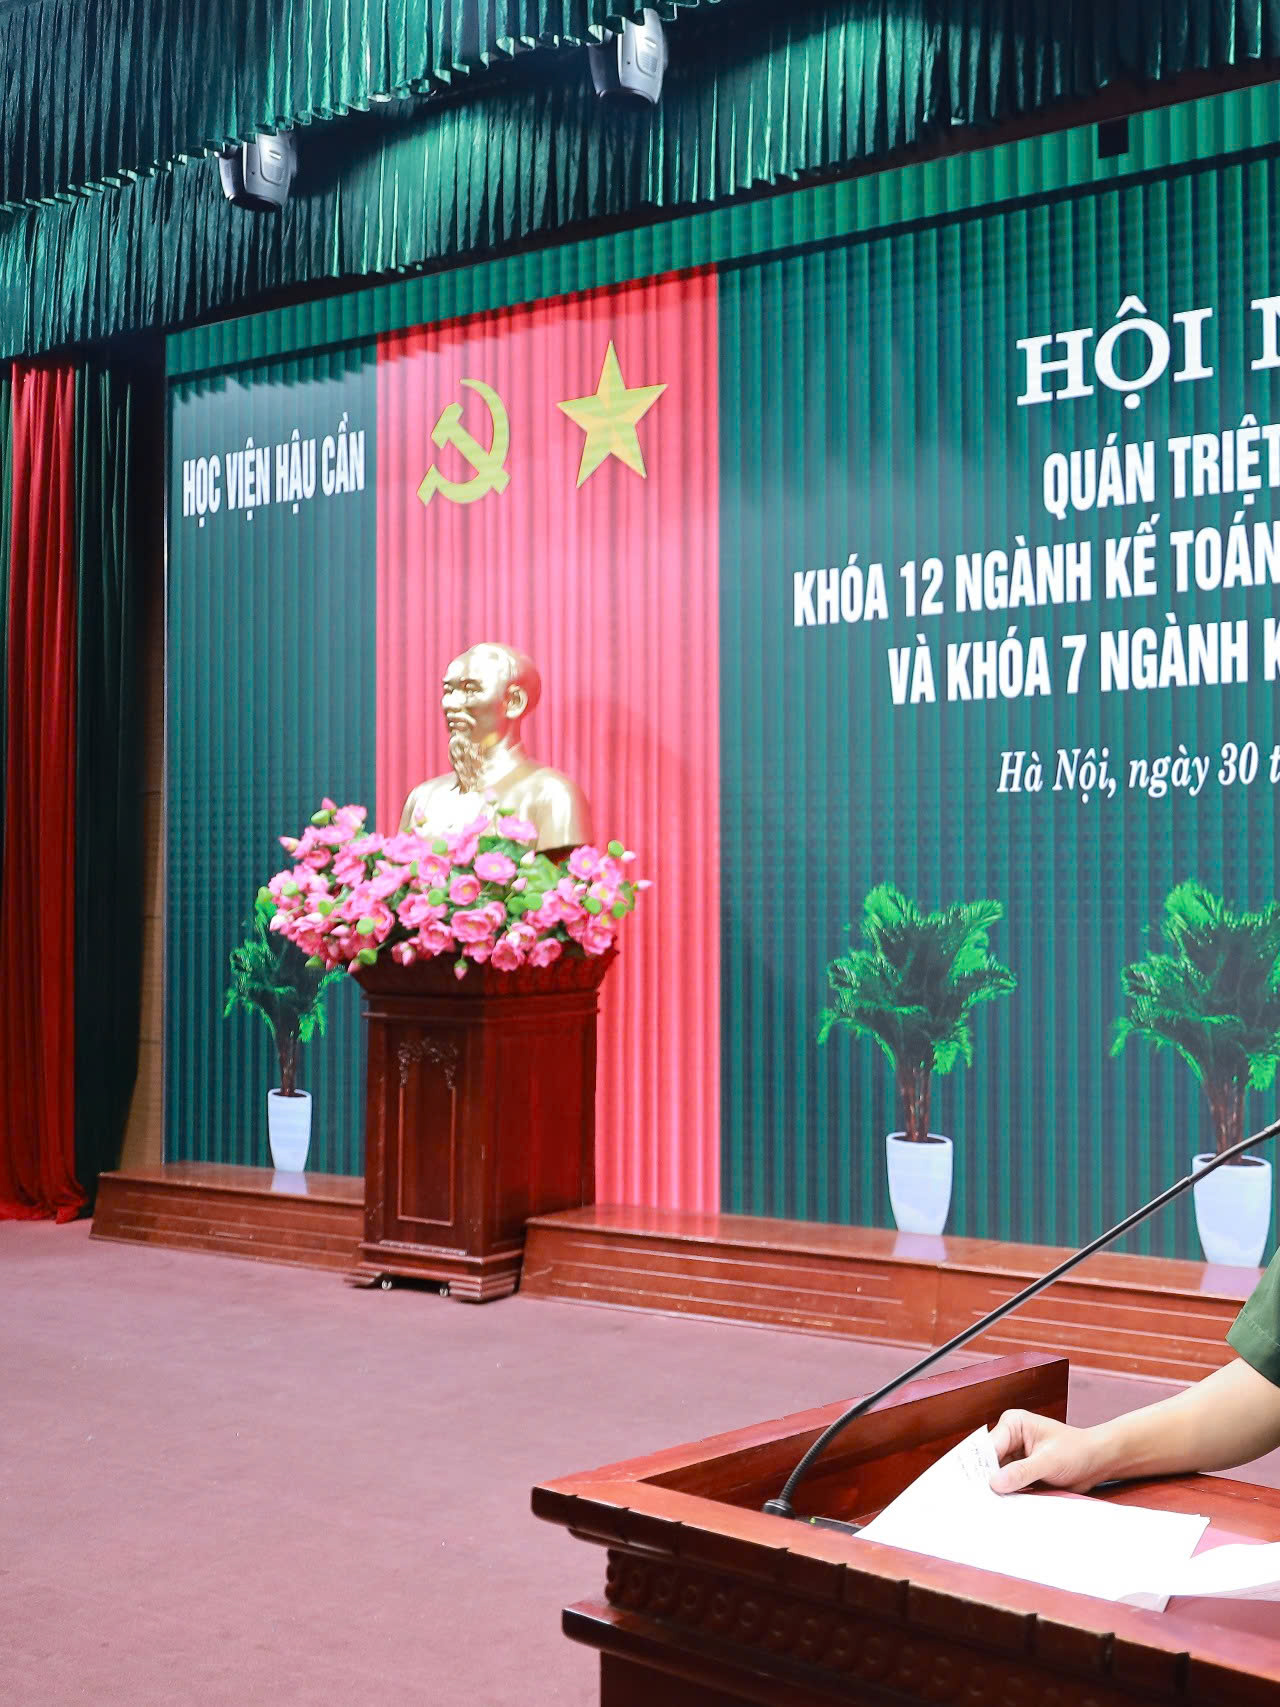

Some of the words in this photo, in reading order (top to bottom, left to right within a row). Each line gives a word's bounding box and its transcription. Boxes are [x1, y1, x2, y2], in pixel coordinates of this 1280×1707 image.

[1016, 295, 1215, 410] HỘI
[183, 454, 221, 528] HỌC
[225, 436, 270, 521] VIỆN
[275, 428, 316, 515] HẬU
[321, 411, 365, 497] CẦN
[1043, 432, 1155, 521] QUÁN
[793, 553, 889, 627] KHÓA
[900, 557, 944, 617] 12
[955, 535, 1092, 613] NGÀNH
[1105, 513, 1160, 599] KẾ
[887, 633, 936, 705] VÀ
[946, 625, 1052, 701] KHÓA
[1062, 634, 1088, 694] 7
[1100, 612, 1249, 692] NGÀNH
[996, 751, 1043, 793] Hà
[1052, 747, 1117, 804] Nội,
[1129, 744, 1210, 798] ngày
[1218, 741, 1259, 786] 30
